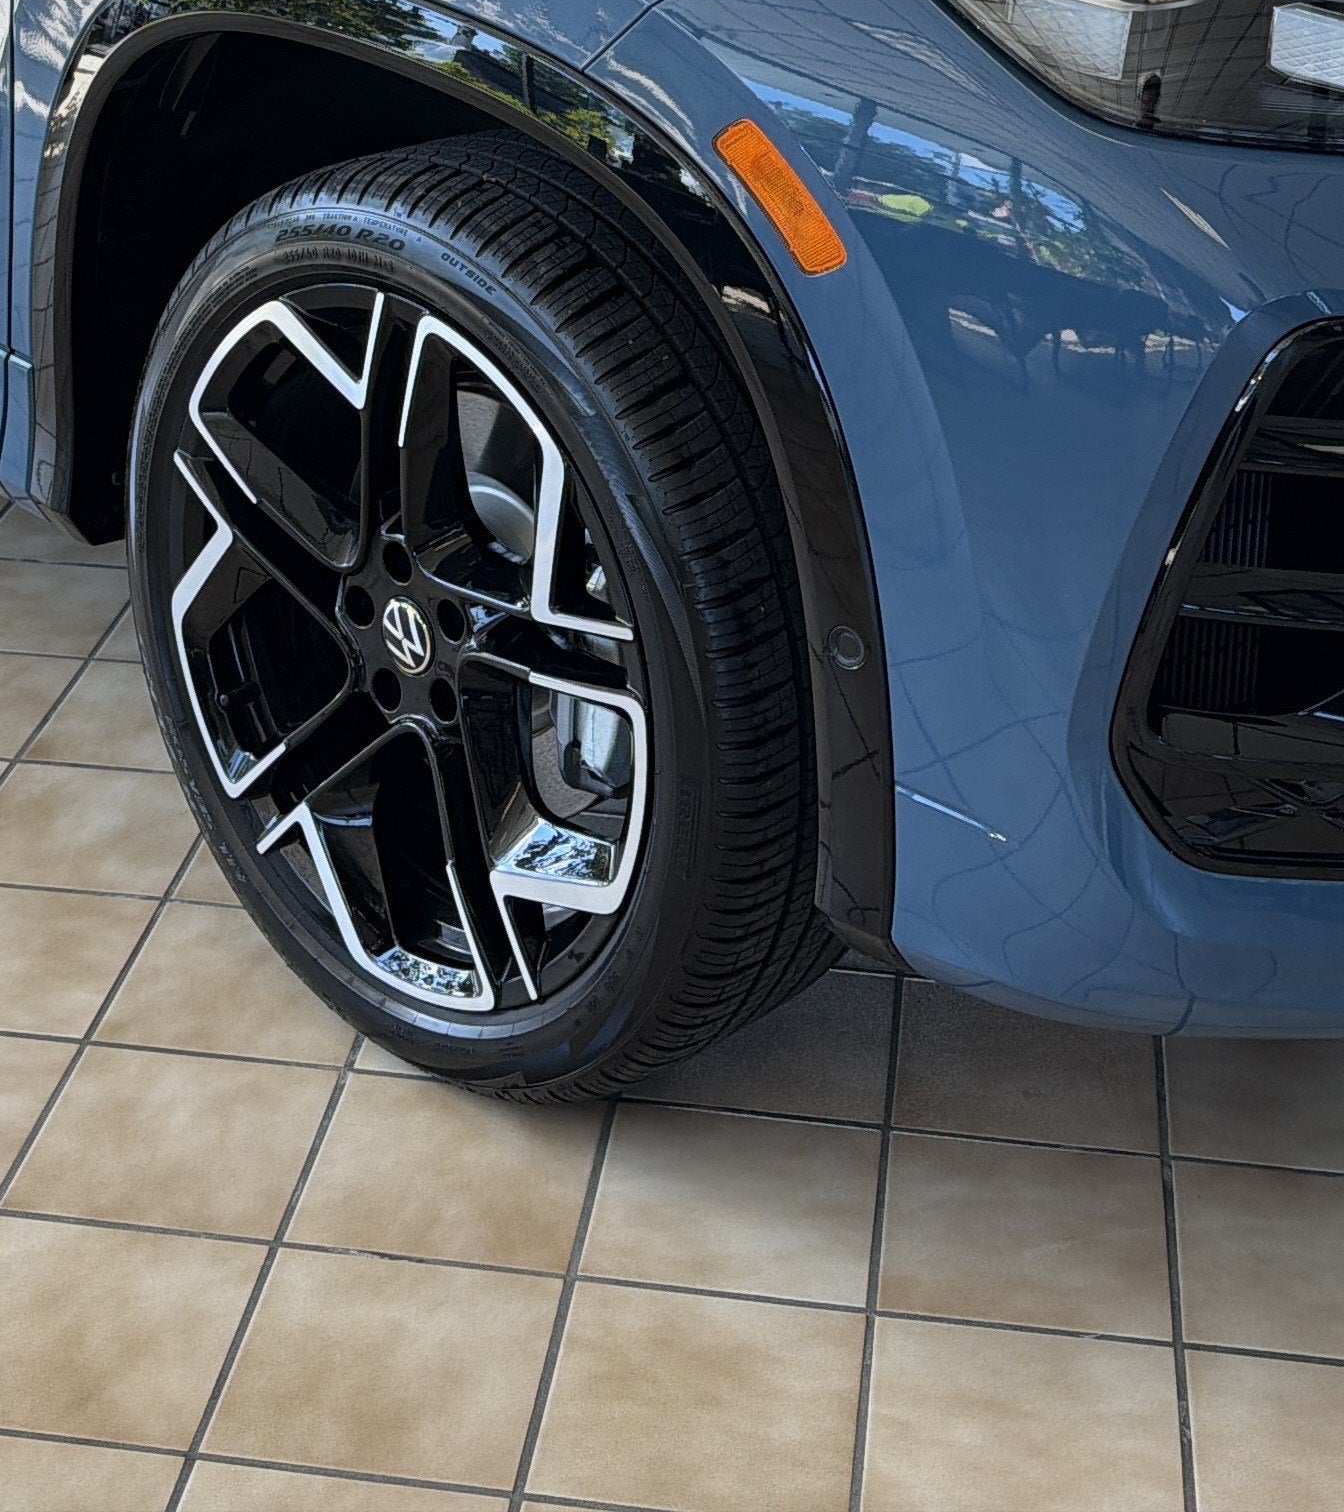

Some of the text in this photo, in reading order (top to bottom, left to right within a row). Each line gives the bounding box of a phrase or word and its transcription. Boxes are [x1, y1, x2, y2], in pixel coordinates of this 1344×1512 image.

[274, 223, 406, 252] 255/40 R20
[441, 252, 498, 296] OUTSIDE
